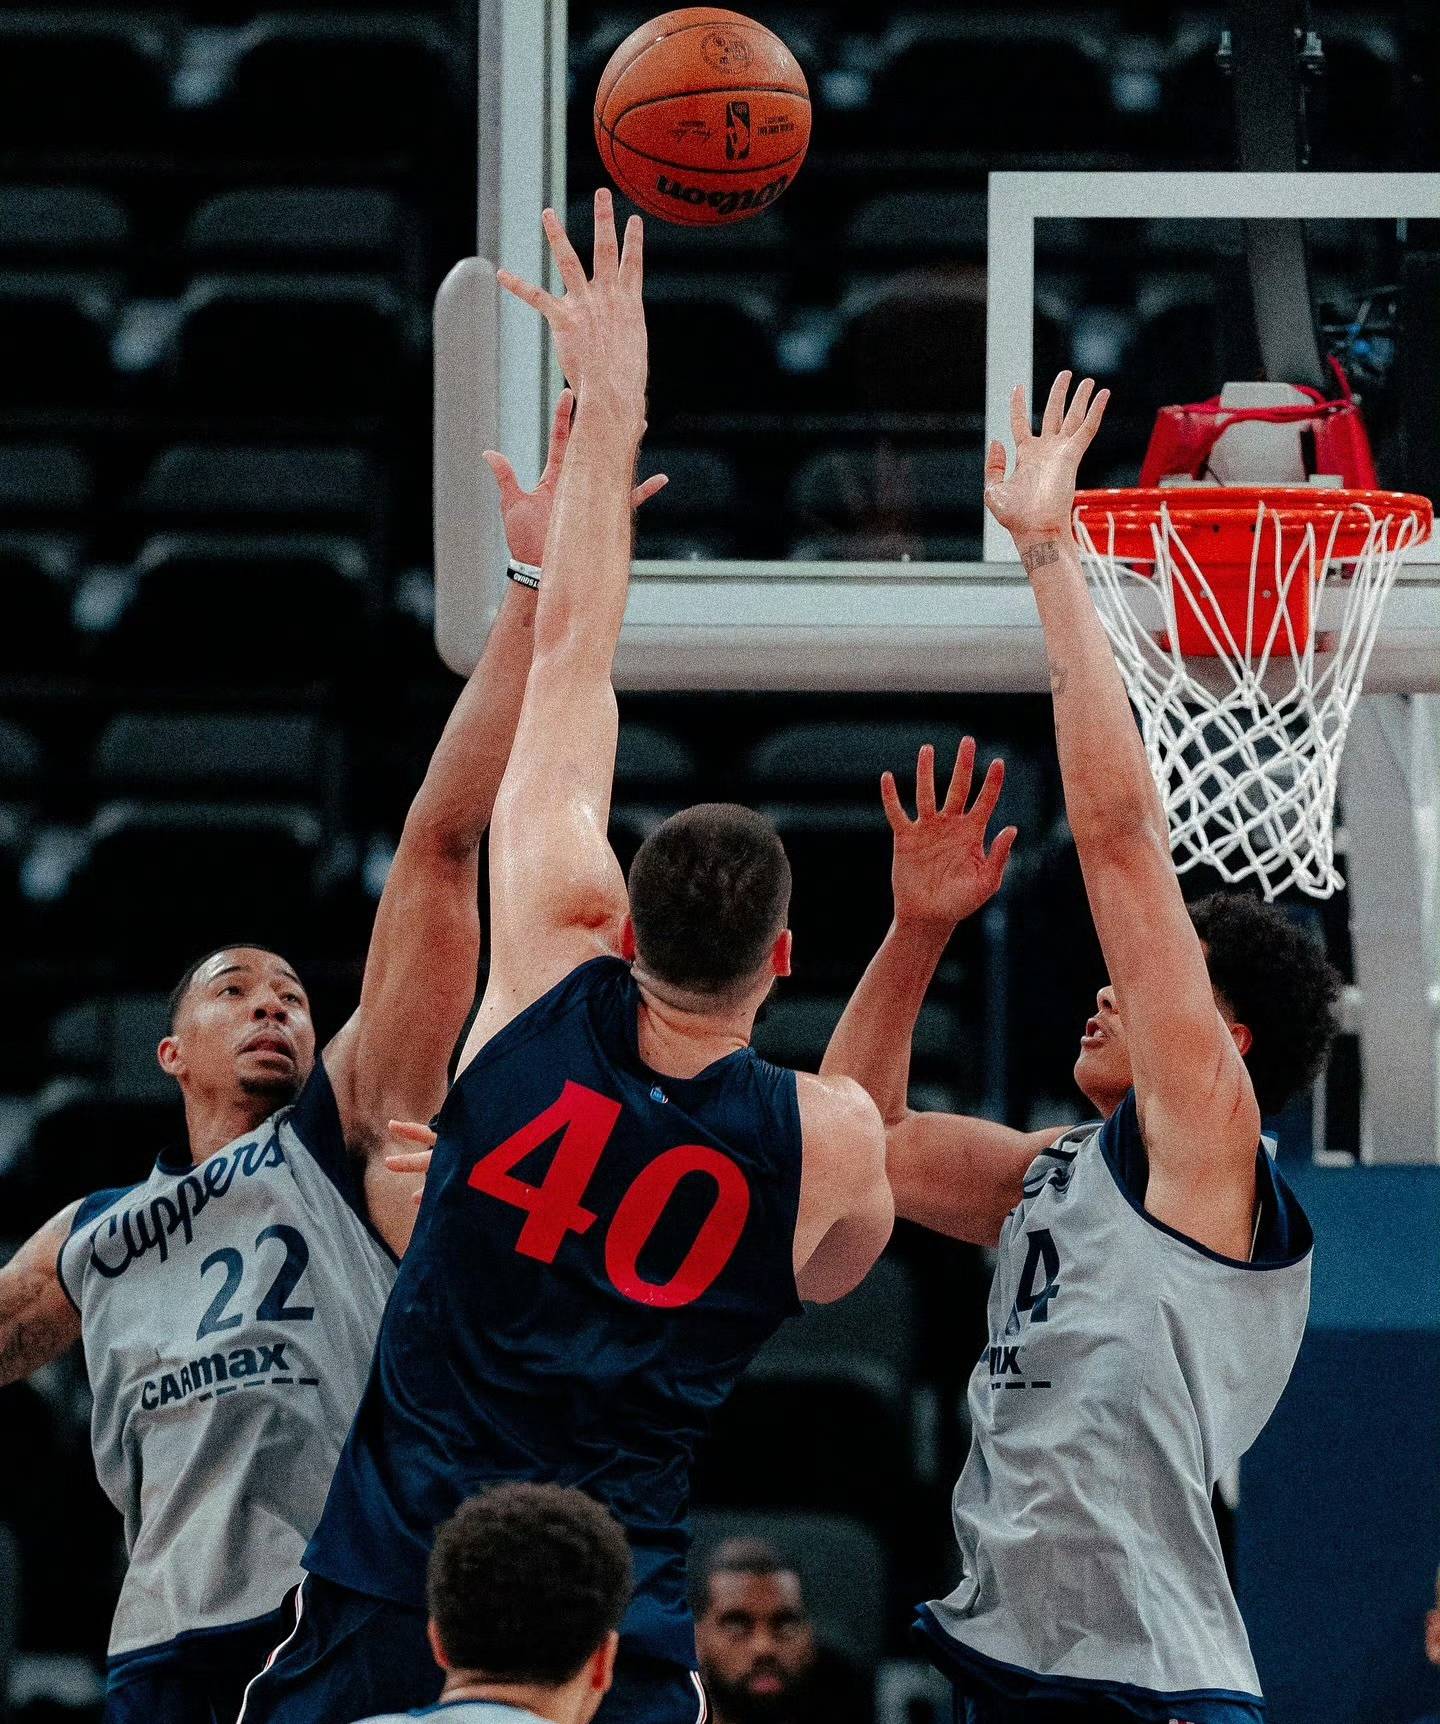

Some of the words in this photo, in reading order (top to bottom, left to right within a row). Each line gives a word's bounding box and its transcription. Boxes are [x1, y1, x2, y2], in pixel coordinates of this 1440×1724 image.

[89, 1133, 286, 1279] Clippers
[458, 1078, 751, 1308] 40
[196, 1224, 315, 1342] 22
